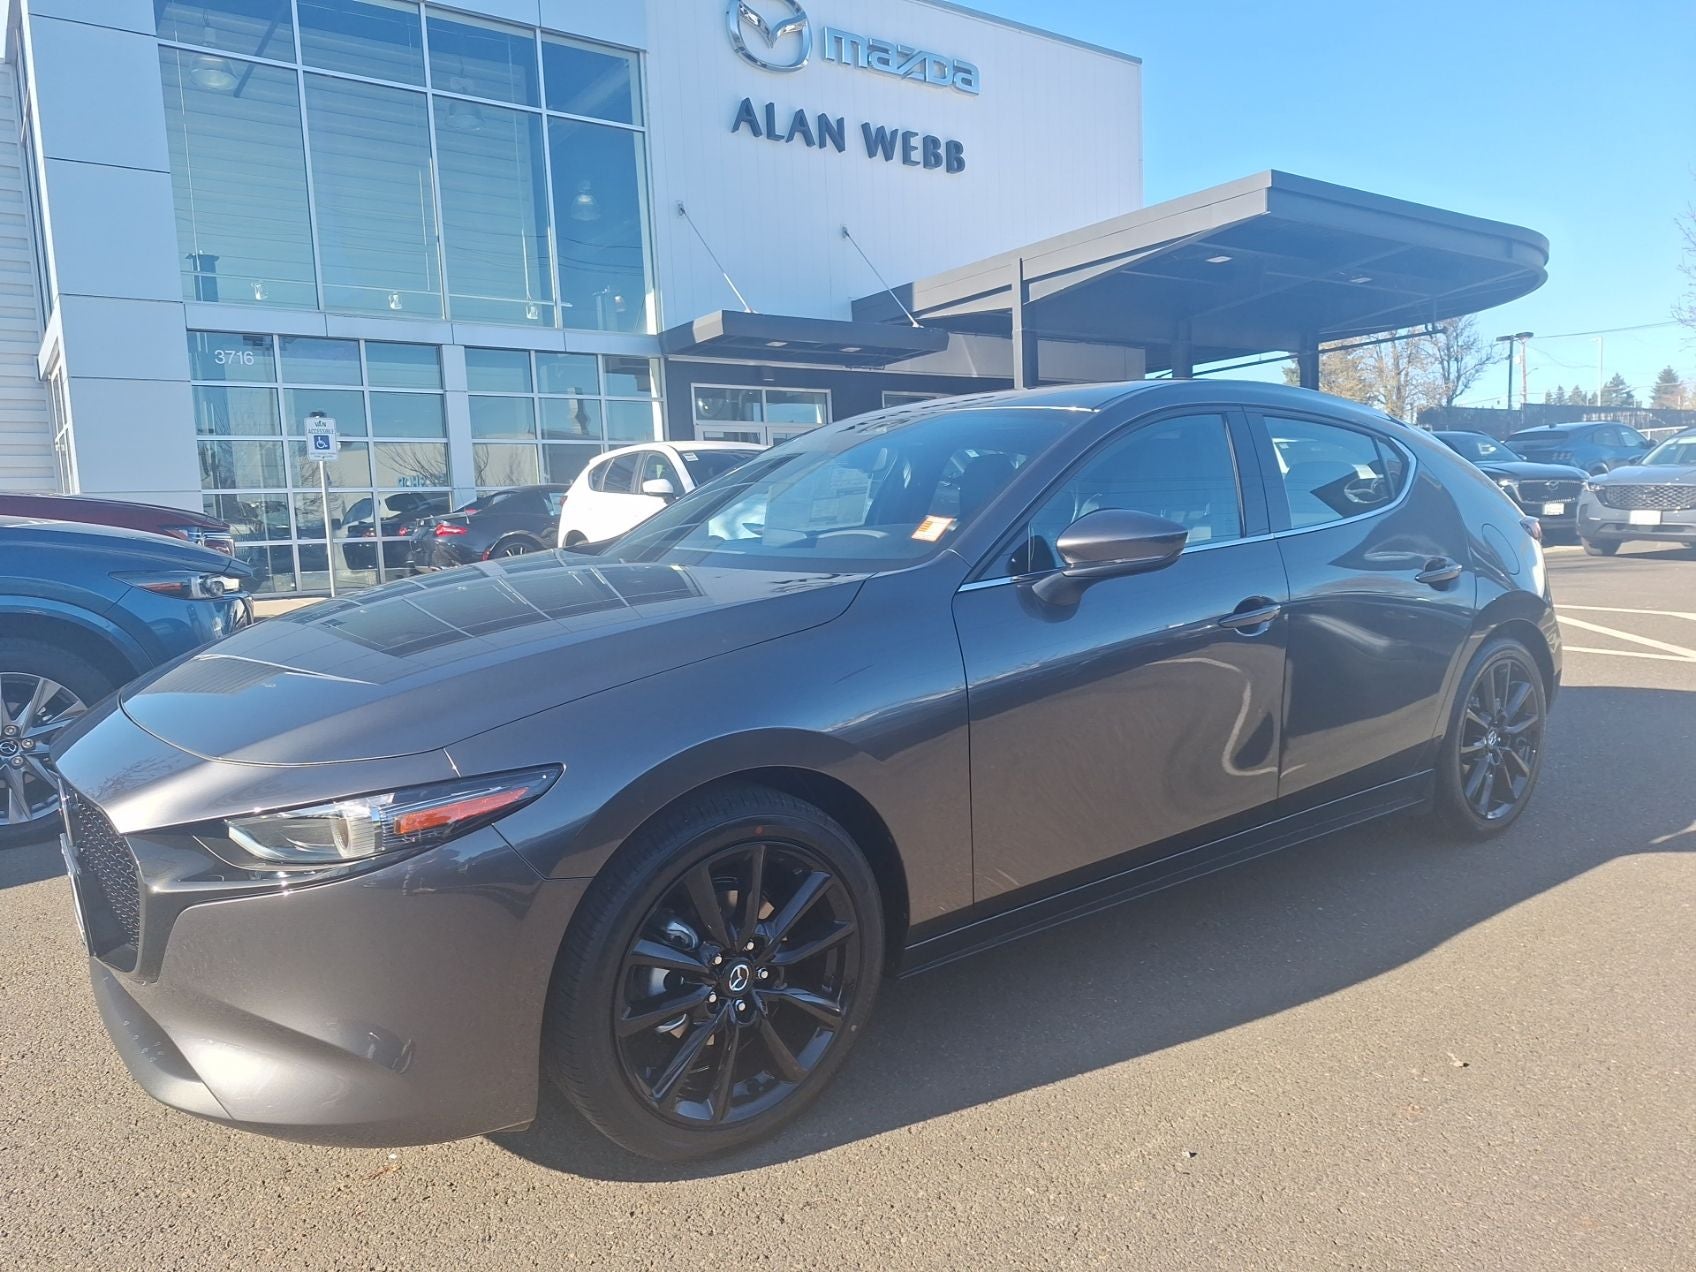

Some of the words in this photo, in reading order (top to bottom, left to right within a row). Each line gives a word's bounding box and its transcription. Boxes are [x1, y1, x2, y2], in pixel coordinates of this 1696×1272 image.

[823, 26, 981, 96] mazda
[731, 97, 846, 153] ALAN
[861, 122, 966, 174] WEBB
[214, 349, 255, 365] 3716
[314, 420, 327, 428] VAN
